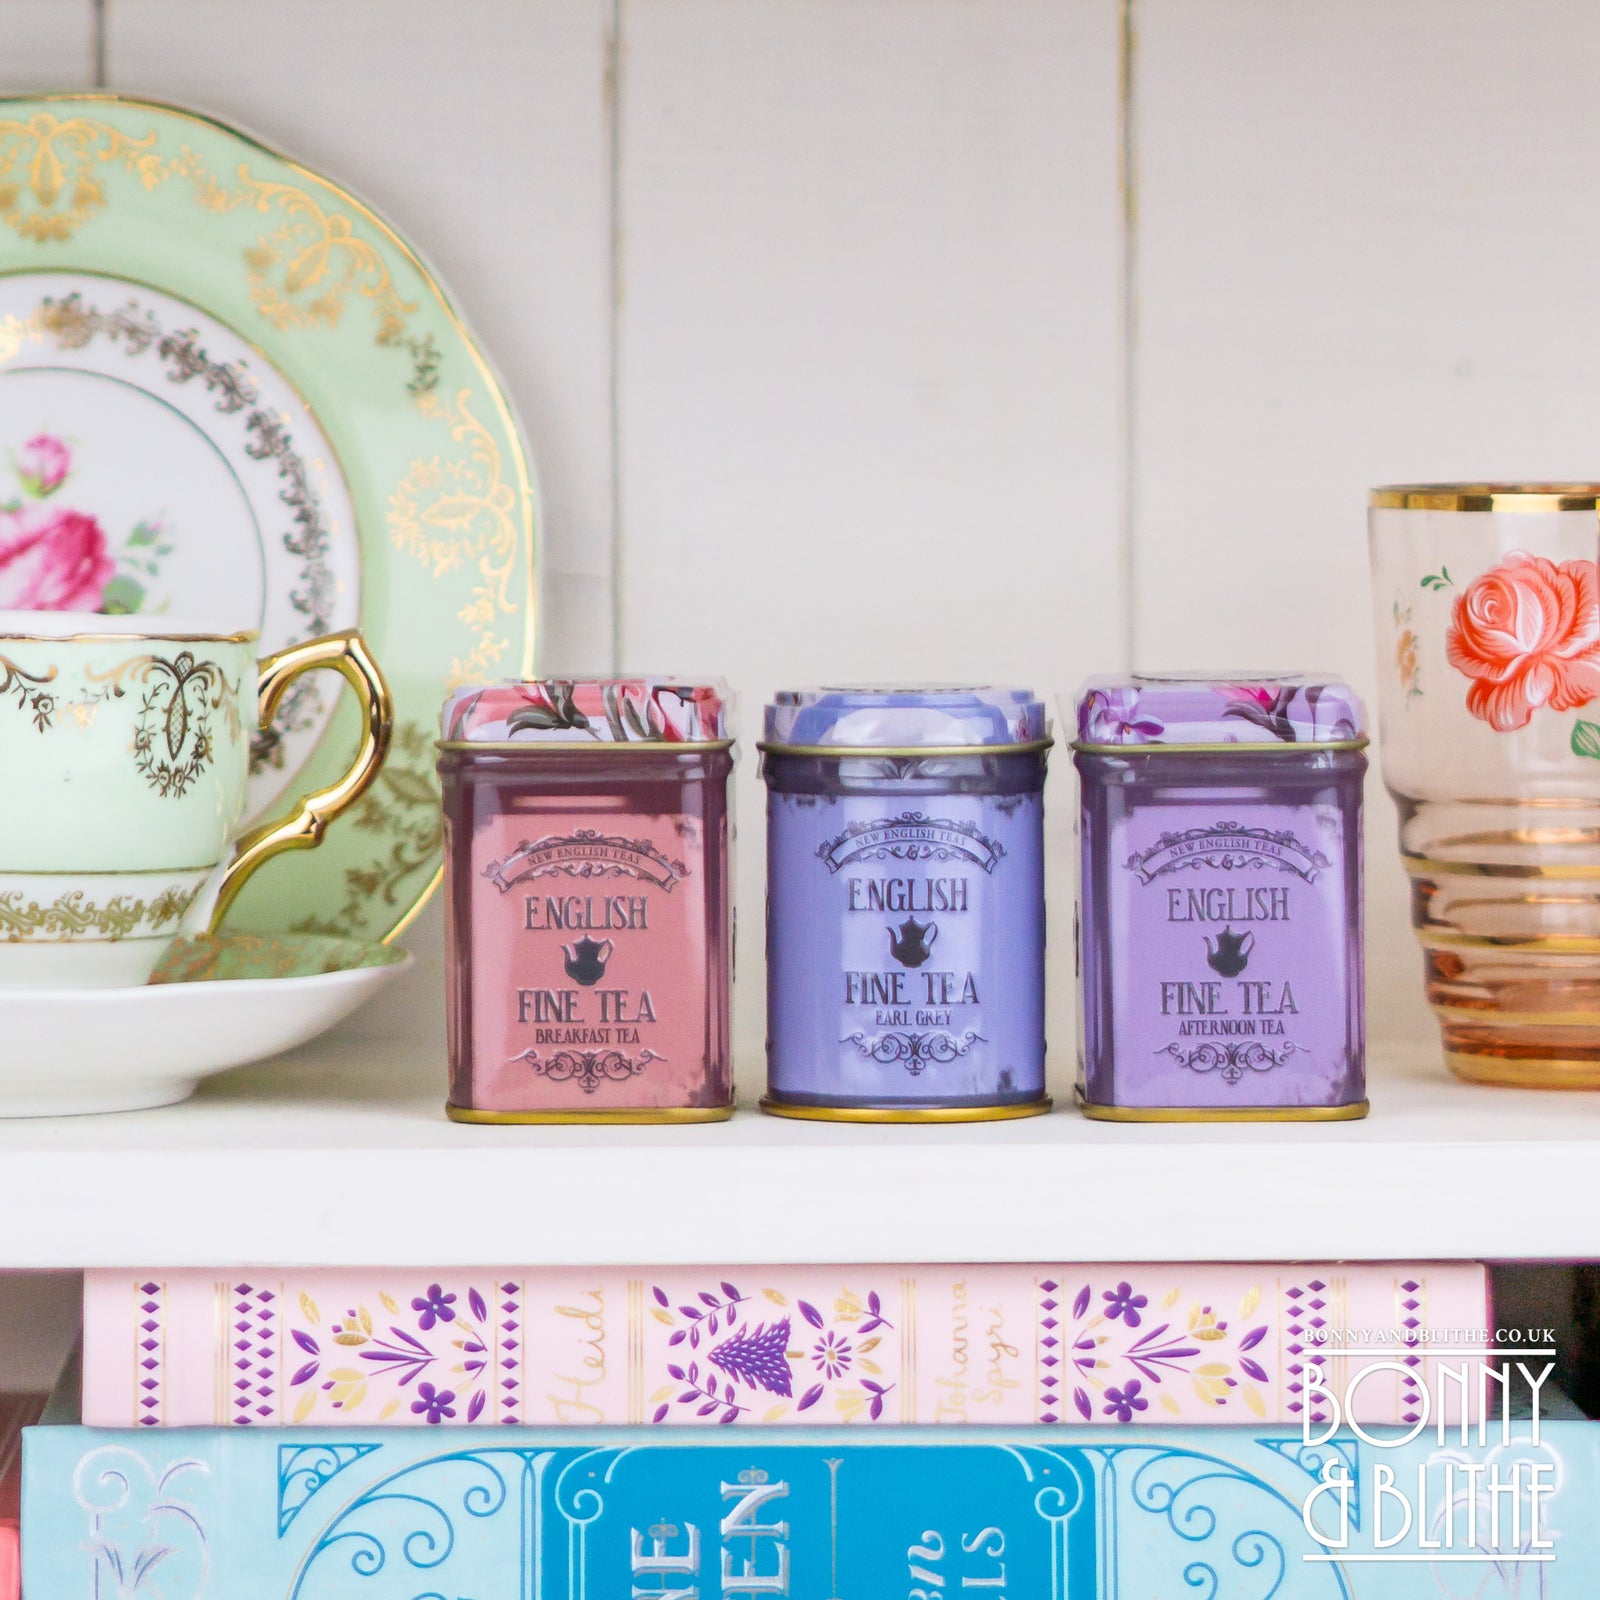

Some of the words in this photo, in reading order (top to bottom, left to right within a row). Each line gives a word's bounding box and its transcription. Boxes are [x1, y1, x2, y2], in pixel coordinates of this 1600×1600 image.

[854, 833, 880, 848] NEW
[884, 828, 935, 841] ENGLISH
[938, 830, 966, 847] TEAS
[1169, 843, 1194, 858] NEW
[1198, 838, 1250, 850] ENGLISH
[1254, 840, 1284, 857] TEAS
[527, 850, 552, 866] NEW
[557, 846, 608, 858] ENGLISH
[612, 849, 641, 865] TEAS
[524, 895, 648, 930] ENGLISH
[847, 877, 968, 913] ENGLISH
[1166, 887, 1290, 922] ENGLISH
[844, 970, 912, 1005] FINE
[921, 970, 980, 1005] TEA
[1160, 981, 1228, 1015] FINE
[1237, 981, 1299, 1015] TEA
[517, 988, 585, 1023] FINE
[594, 988, 657, 1023] TEA
[875, 1010, 912, 1026] EARL
[915, 1010, 952, 1026] GREY
[535, 1028, 612, 1044] BREAKFAST
[615, 1028, 641, 1044] TEA
[1178, 1019, 1256, 1036] AFTERNOON
[1259, 1019, 1285, 1035] TEA
[546, 1283, 606, 1424] Heidi
[934, 1278, 969, 1424] Johanna
[971, 1302, 1021, 1404] Spyri
